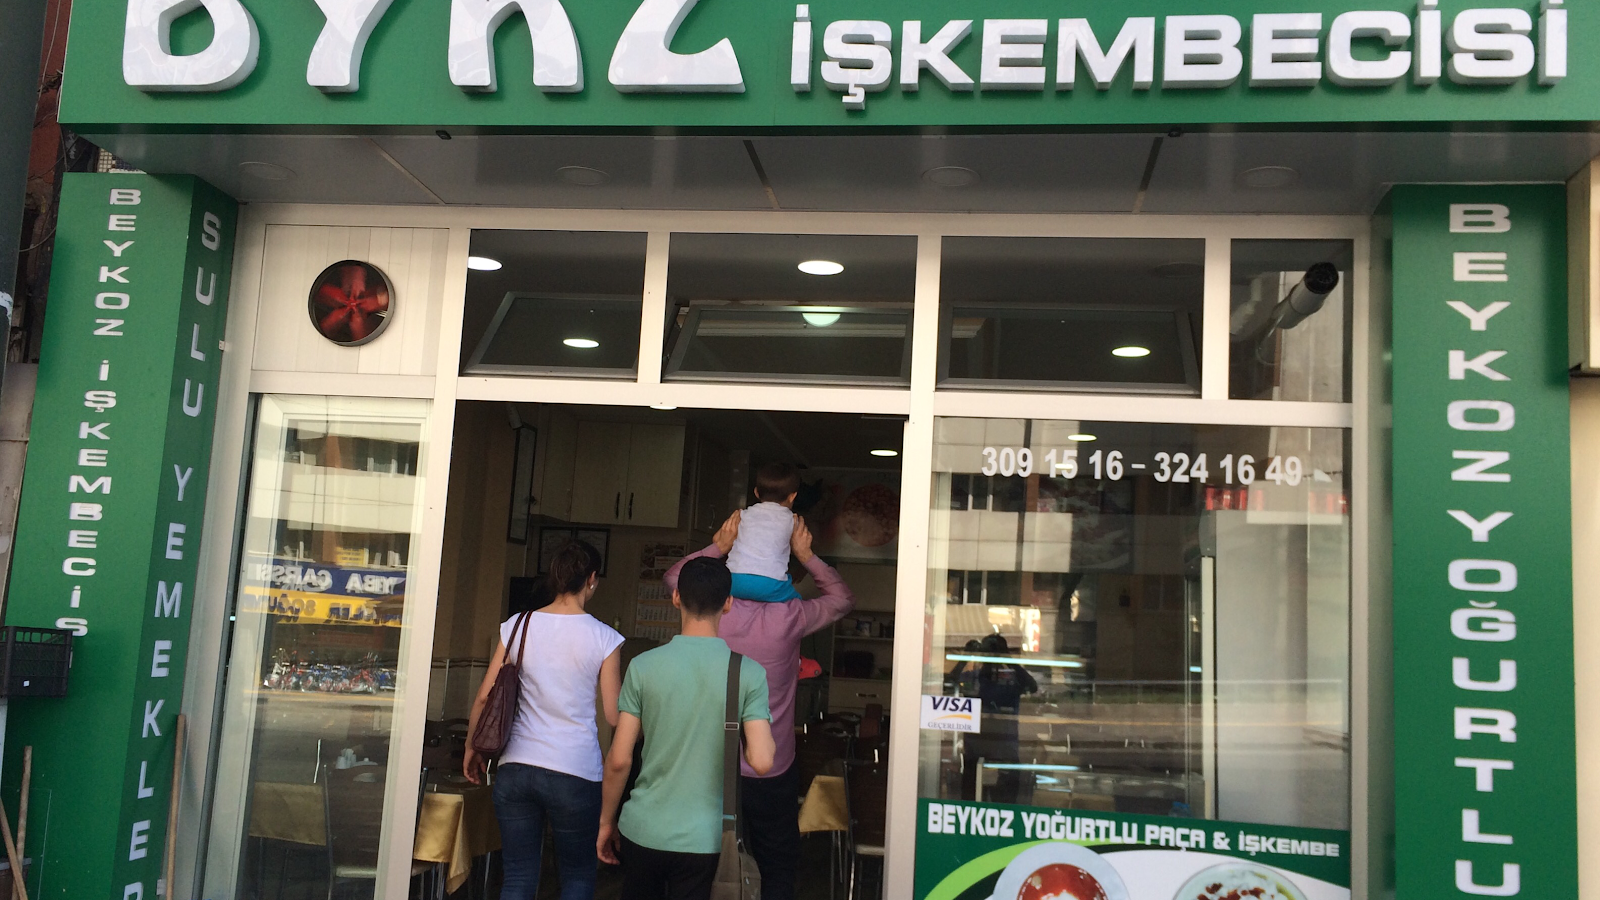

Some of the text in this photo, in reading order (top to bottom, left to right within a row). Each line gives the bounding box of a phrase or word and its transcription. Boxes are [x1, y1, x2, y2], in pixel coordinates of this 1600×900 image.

[790, 0, 1568, 110] İŞKEMBECİSİ
[182, 211, 222, 418] SULU
[55, 188, 142, 668] BEYKOZ İŞKEMBECİS
[981, 446, 1034, 478] 309
[1044, 448, 1078, 480] 15
[1089, 449, 1124, 481] 16
[1153, 451, 1209, 484] 324
[1219, 453, 1256, 485] 16
[1265, 455, 1303, 487] 49
[1446, 203, 1521, 897] BEYKOZ YOĞURTLU
[931, 696, 973, 713] VISA
[927, 803, 1340, 857] BEYKOZ YOĞURTLU PAÇA & İŞKEMBE
